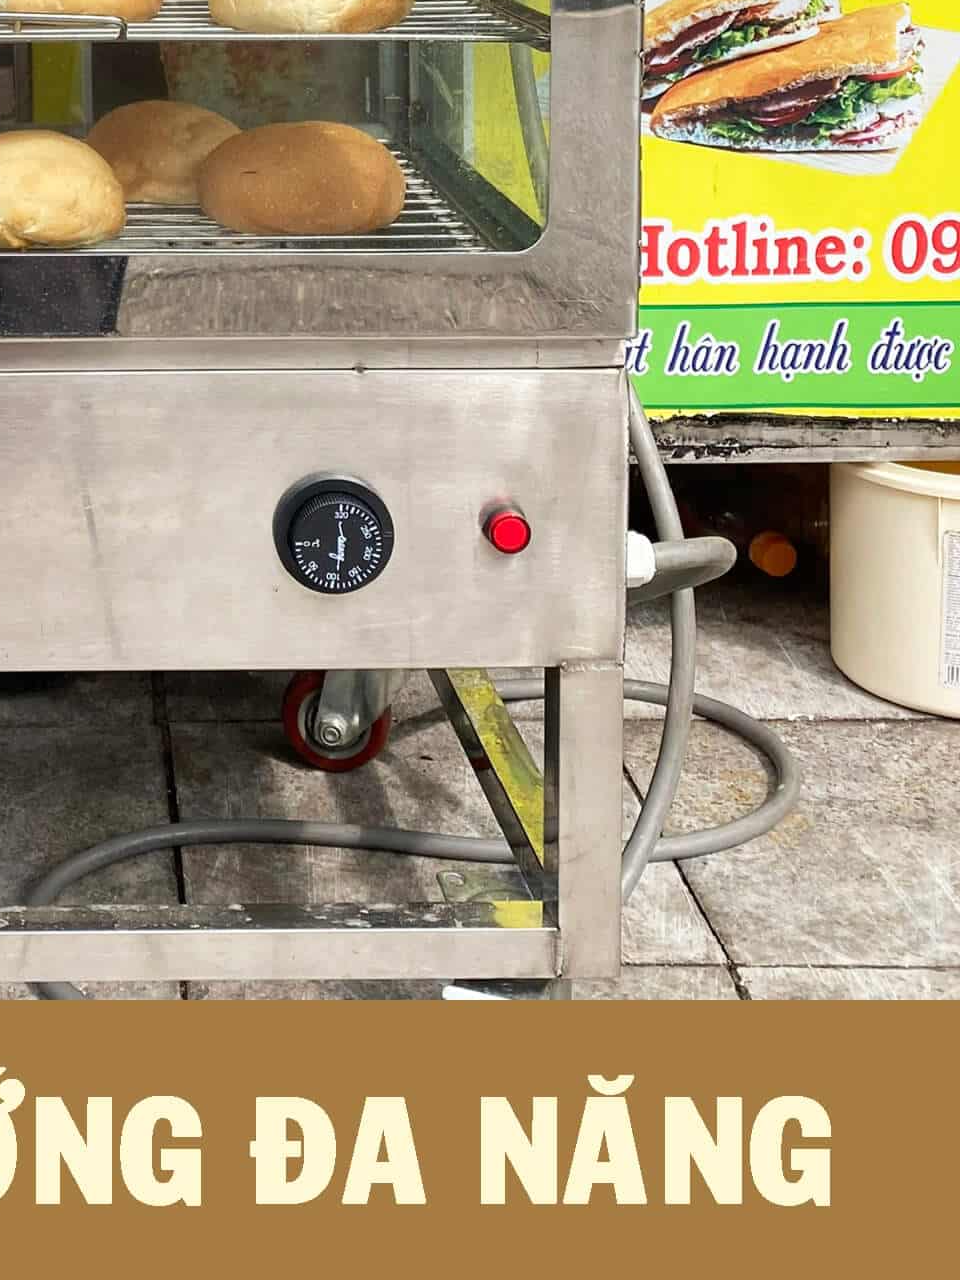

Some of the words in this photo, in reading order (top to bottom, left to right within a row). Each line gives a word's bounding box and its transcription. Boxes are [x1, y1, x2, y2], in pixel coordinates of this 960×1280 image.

[892, 220, 960, 274] 09
[668, 324, 737, 372] hân
[757, 320, 849, 379] hạnh
[871, 321, 951, 379] được
